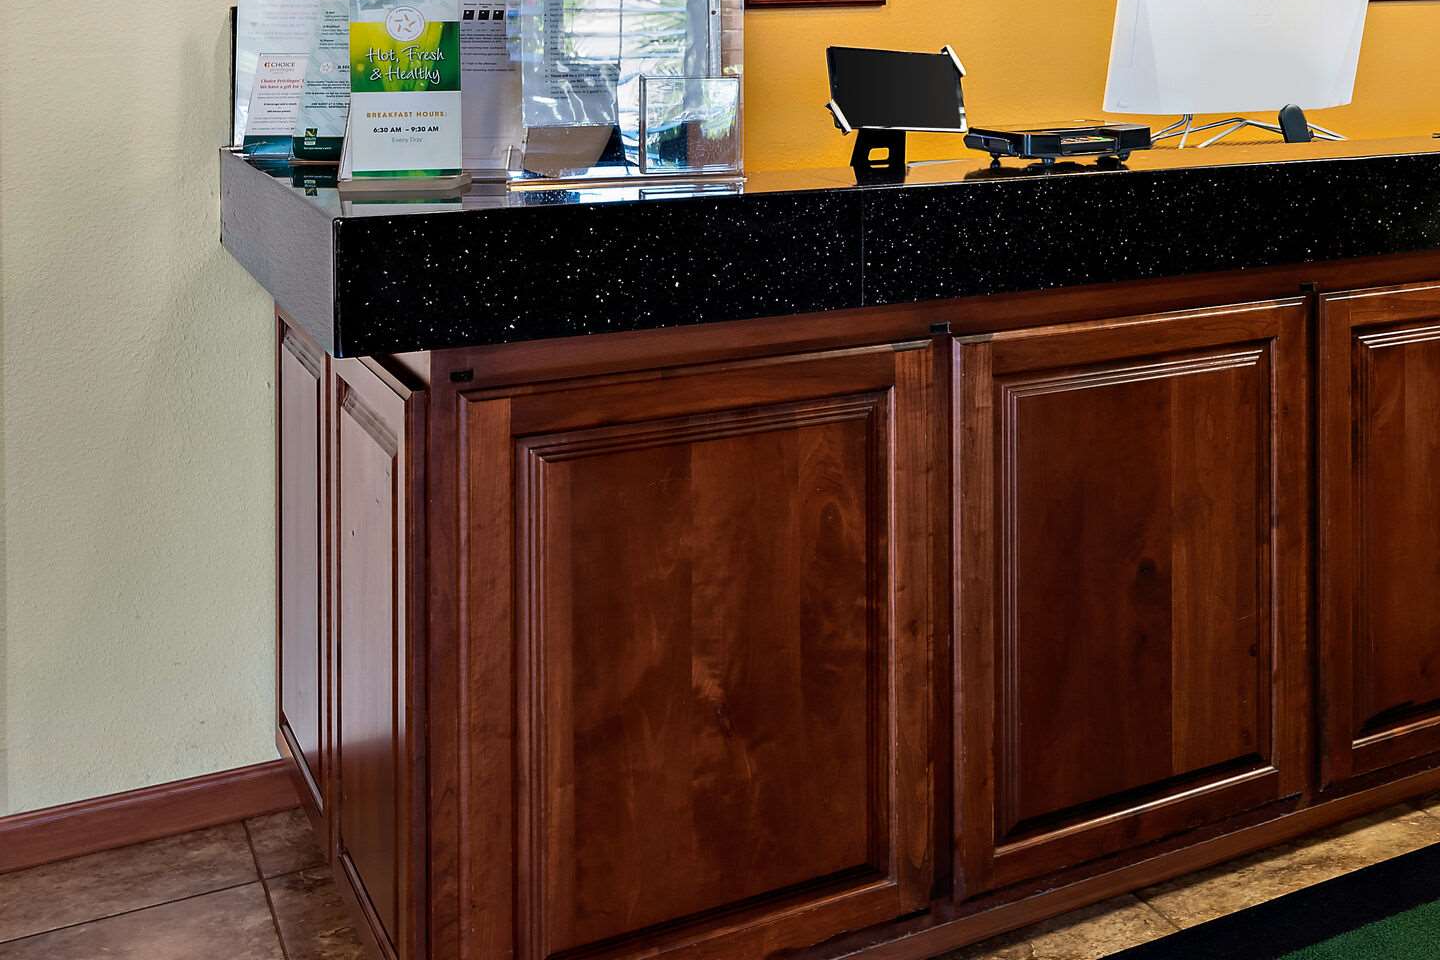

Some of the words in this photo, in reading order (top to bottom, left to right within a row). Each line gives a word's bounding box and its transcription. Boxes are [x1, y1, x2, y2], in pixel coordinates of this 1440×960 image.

[365, 47, 400, 63] Hot,
[401, 44, 445, 64] Fresh
[369, 68, 383, 81] &
[385, 64, 441, 85] Healthy
[366, 111, 413, 119] BREAKFAST
